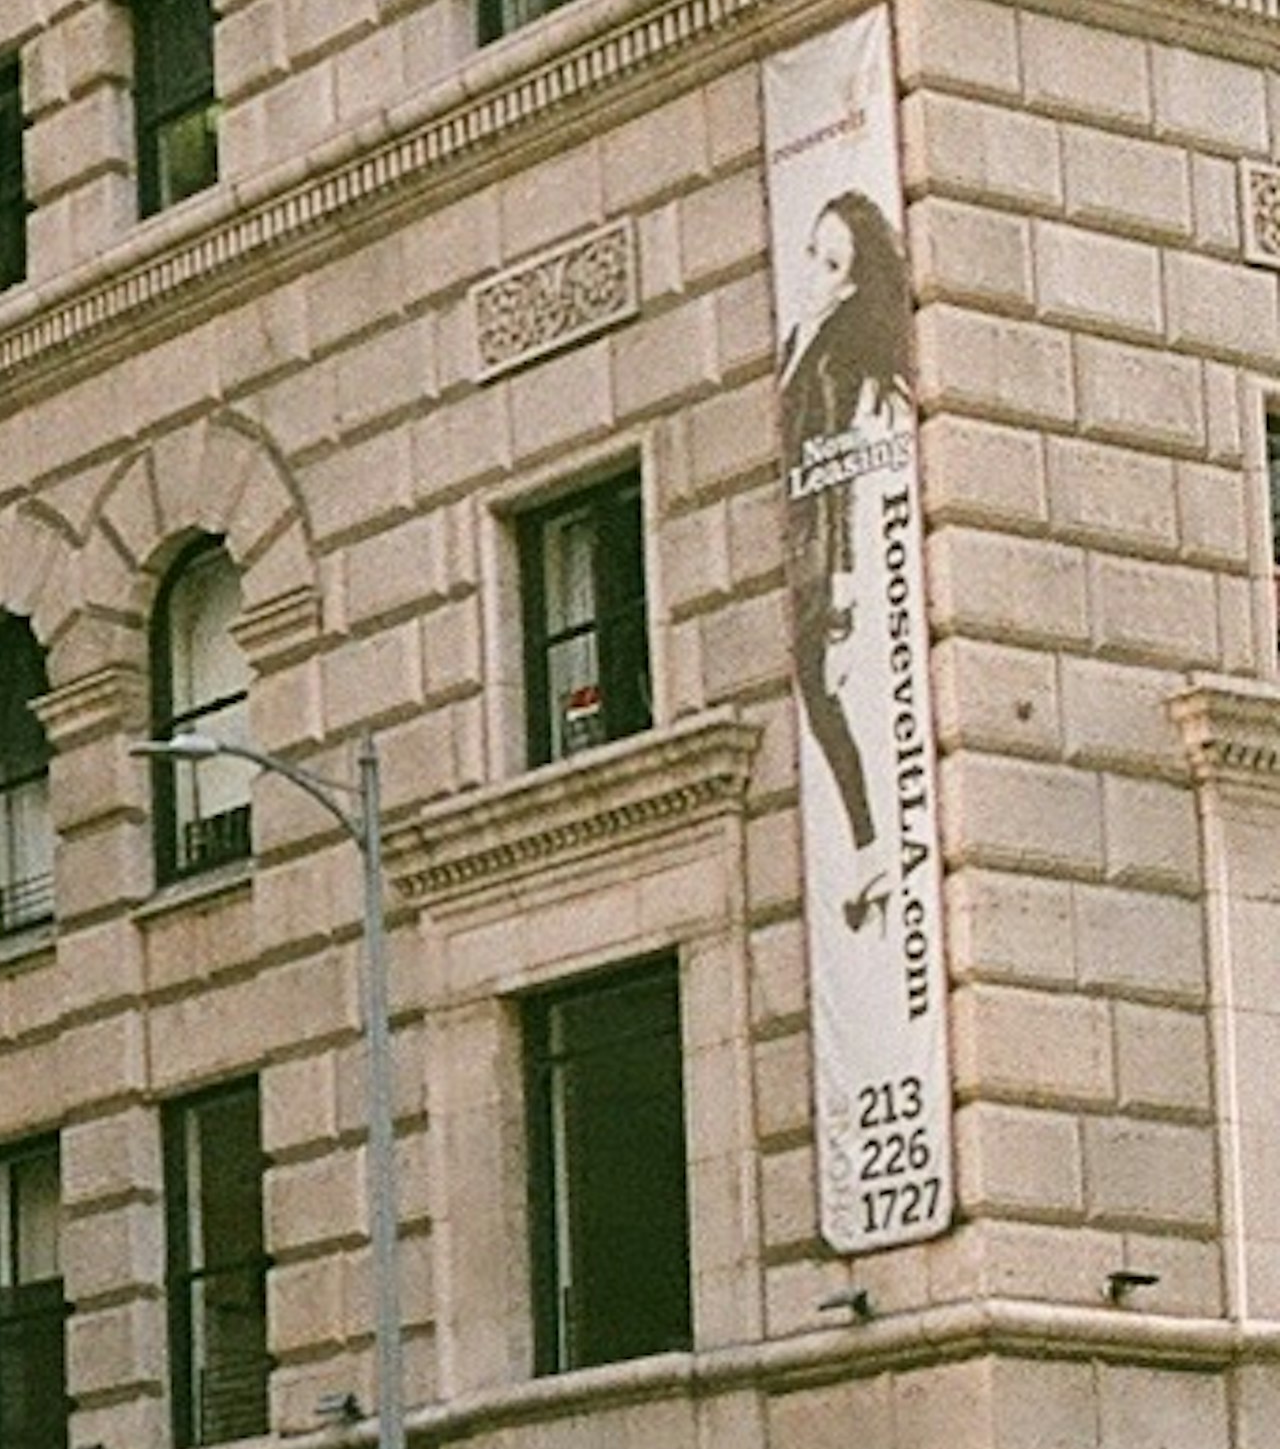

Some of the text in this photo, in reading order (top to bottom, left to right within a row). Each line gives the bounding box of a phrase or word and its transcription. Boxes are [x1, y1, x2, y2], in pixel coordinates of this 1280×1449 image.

[788, 432, 911, 501] Leasing
[881, 485, 931, 1022] RooseveltLA.com
[858, 1075, 922, 1129] 213
[860, 1127, 931, 1181] 226
[861, 1176, 943, 1234] 1727
